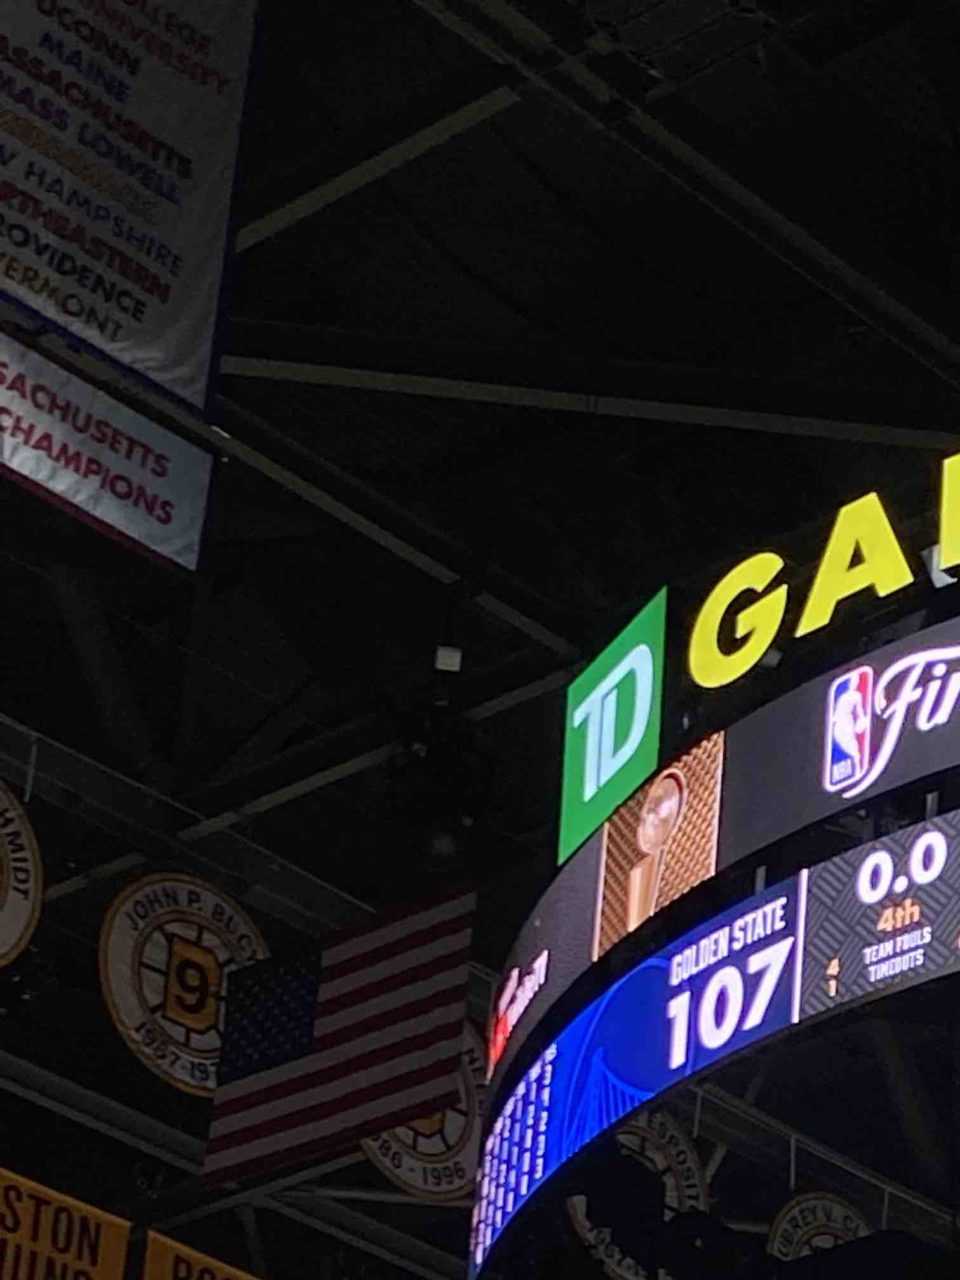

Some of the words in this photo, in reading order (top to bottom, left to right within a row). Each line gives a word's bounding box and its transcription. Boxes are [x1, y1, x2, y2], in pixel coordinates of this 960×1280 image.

[25, 161, 183, 277] HAMPSHIRE
[0, 407, 175, 524] CHAMPIONS
[570, 639, 654, 802] TD
[857, 831, 949, 904] 0.0
[126, 888, 178, 931] JOHN
[669, 932, 729, 986] GOLDEN
[732, 897, 788, 953] STATE
[876, 897, 921, 932] 4th
[176, 958, 210, 1014] 9
[827, 958, 840, 976] 4
[863, 941, 896, 964] TEAM
[899, 926, 931, 956] FOULS
[868, 951, 924, 982] TIMEOUTS
[667, 936, 795, 1070] 107
